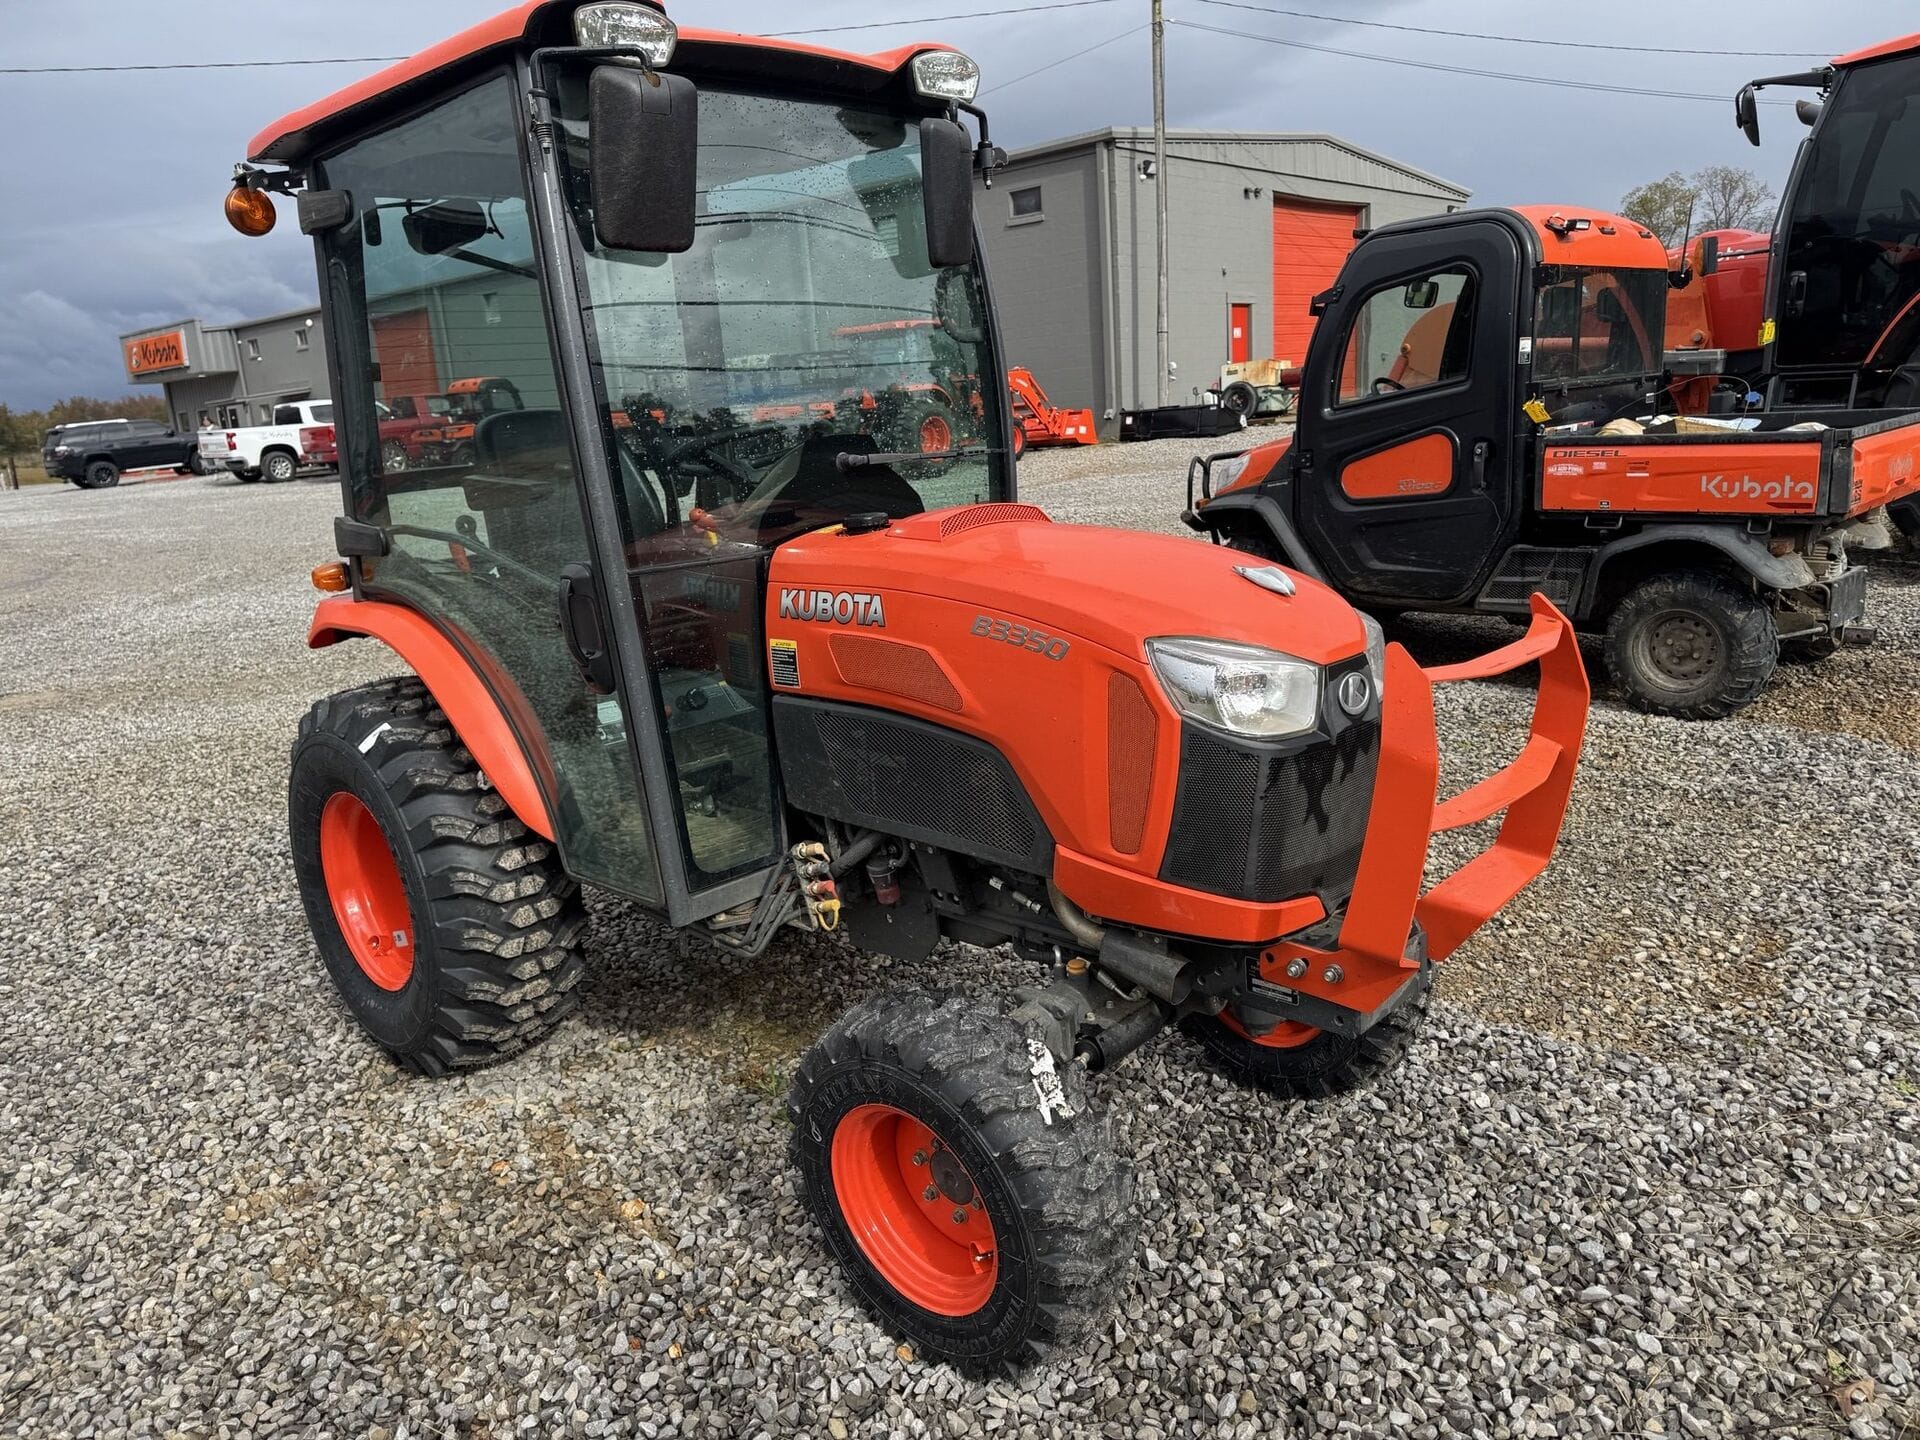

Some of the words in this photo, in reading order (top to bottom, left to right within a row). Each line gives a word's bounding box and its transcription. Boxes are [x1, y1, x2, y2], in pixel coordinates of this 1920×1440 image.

[141, 340, 178, 365] Kubota
[1553, 449, 1627, 458] DIESEL
[1701, 475, 1813, 499] Kubota
[780, 588, 885, 627] KUBOTA
[970, 614, 1070, 661] B3350
